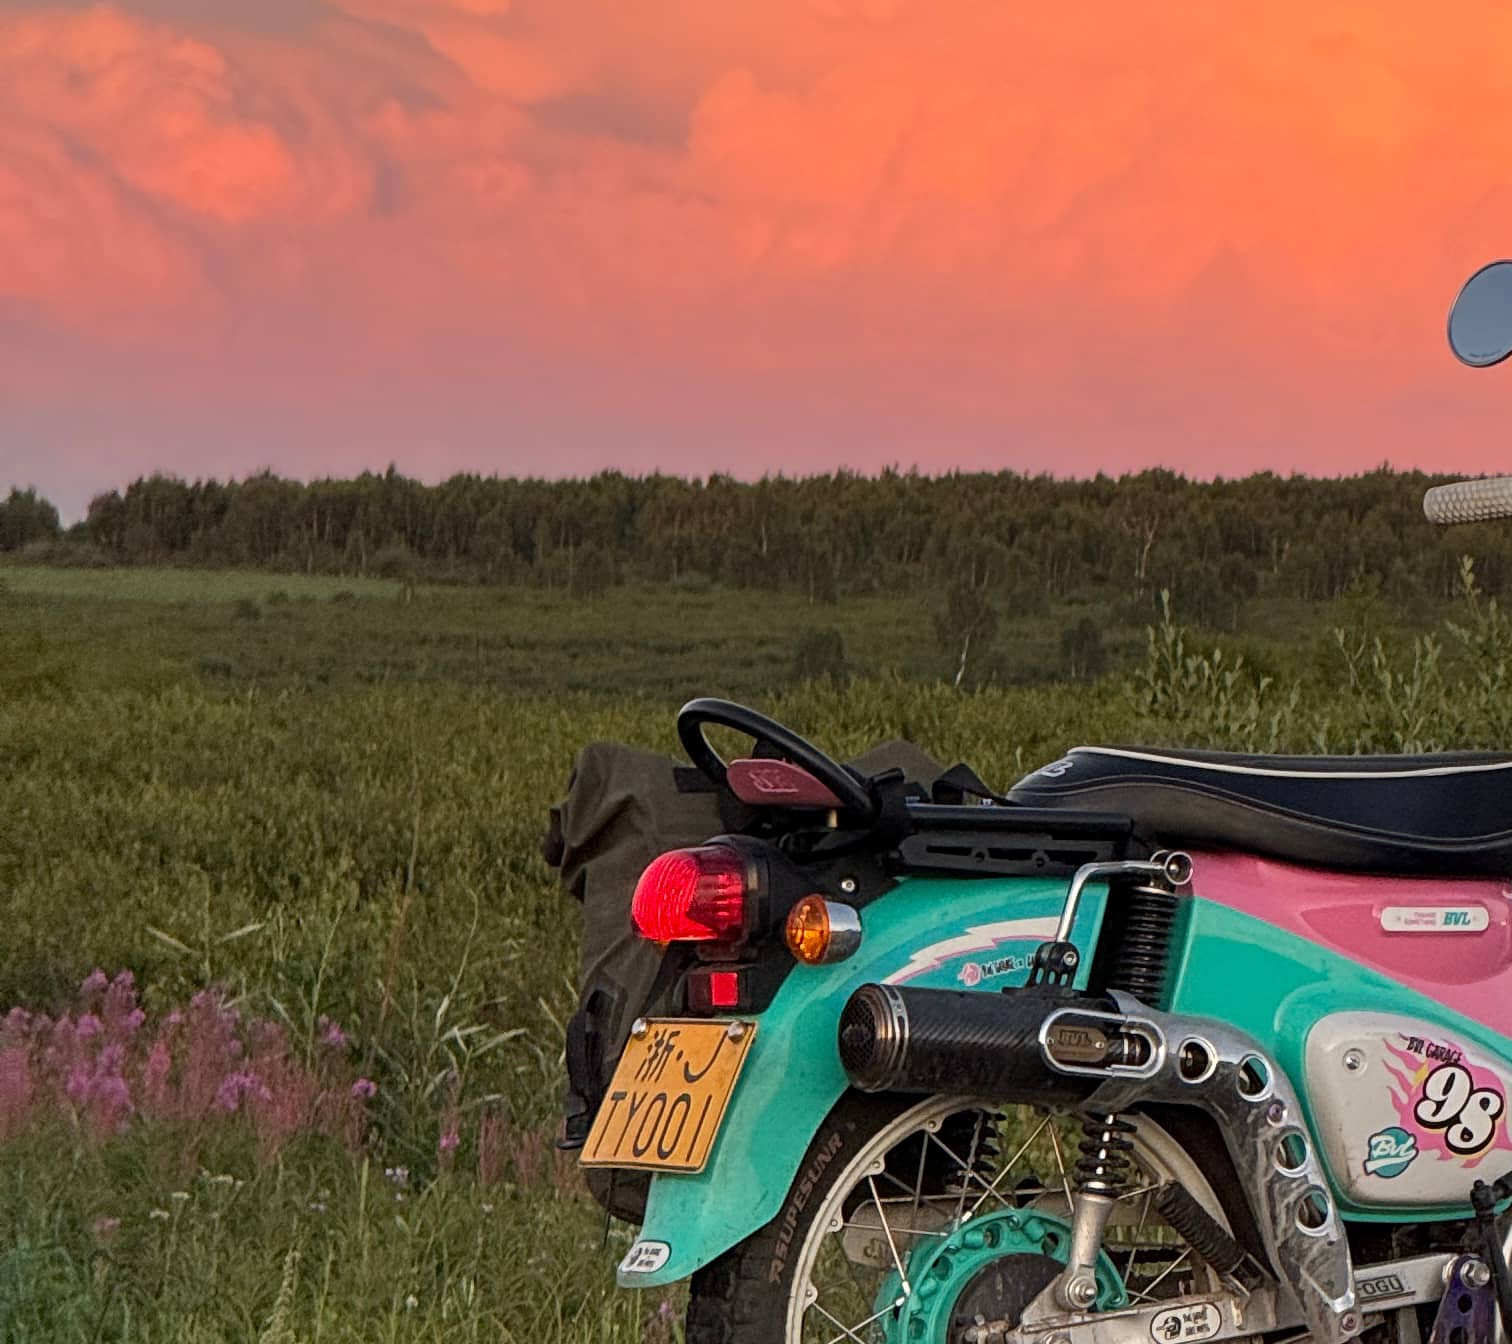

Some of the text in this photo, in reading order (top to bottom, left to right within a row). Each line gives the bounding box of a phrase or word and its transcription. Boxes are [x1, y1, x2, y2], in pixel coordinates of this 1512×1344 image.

[1443, 911, 1471, 926] BVL
[592, 1091, 713, 1162] TY001
[1414, 1063, 1504, 1154] 98
